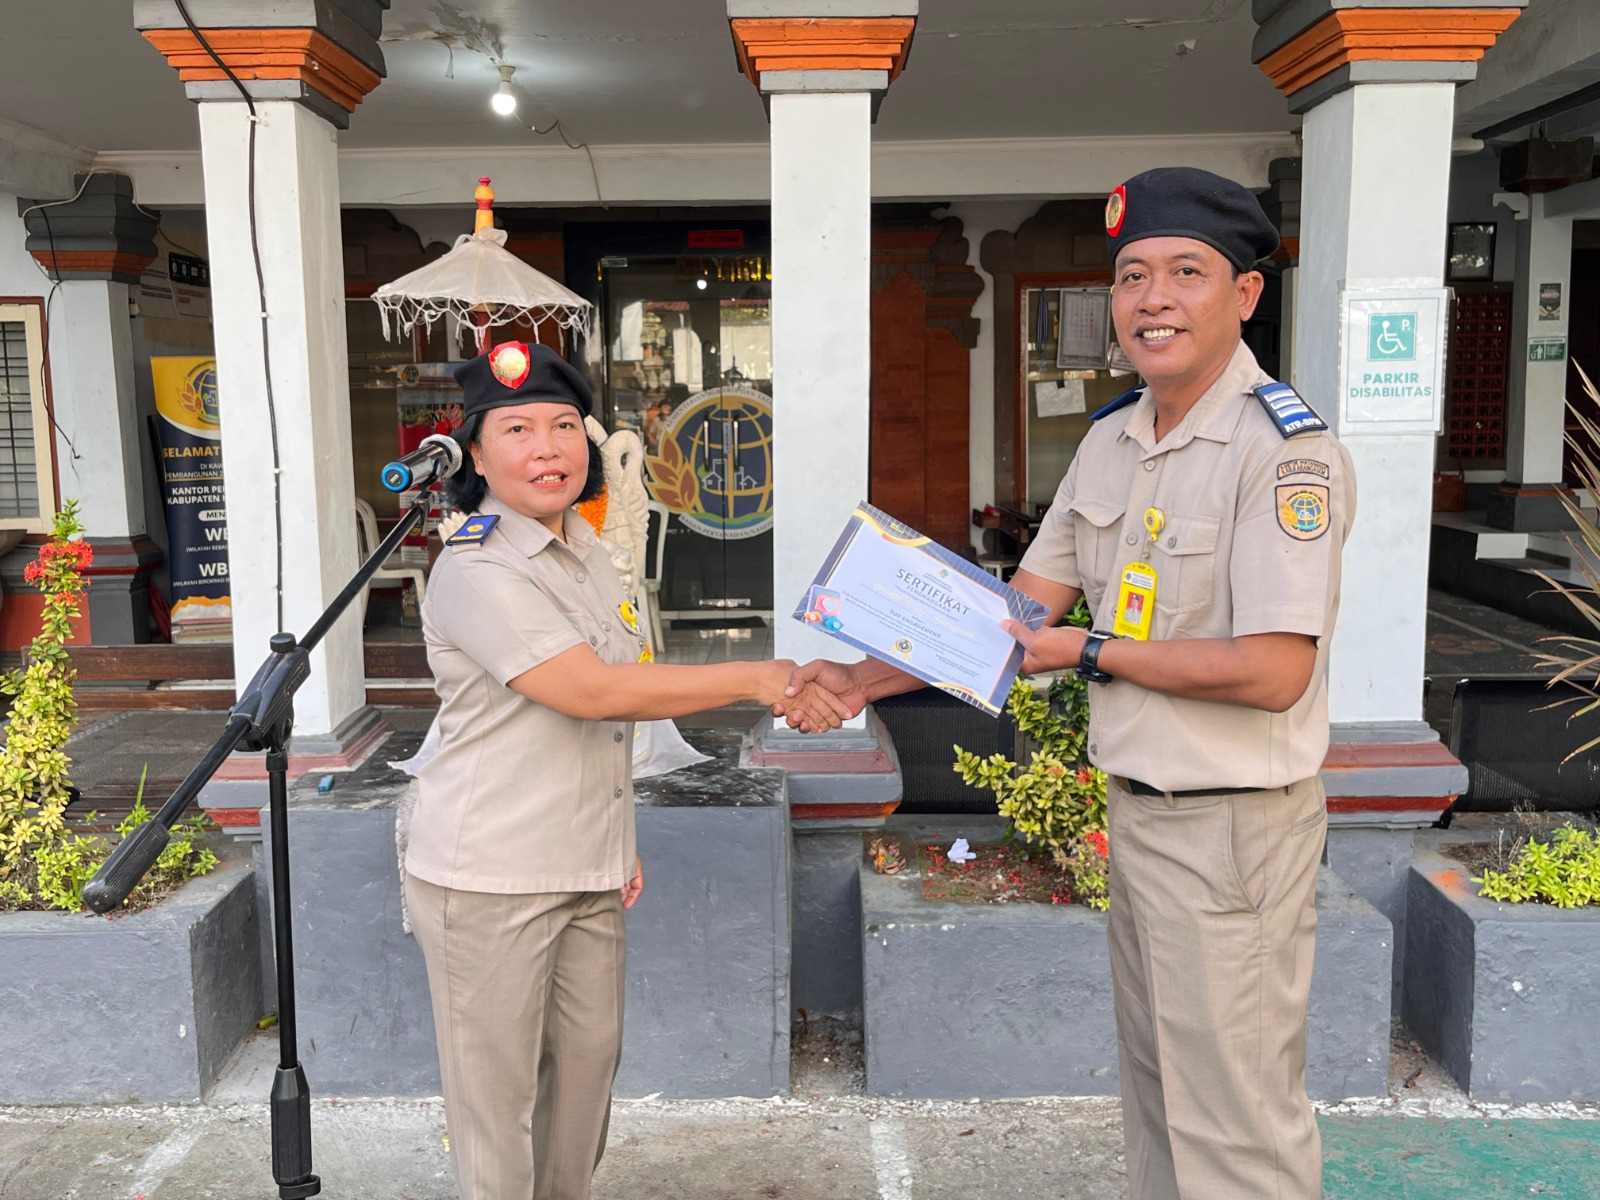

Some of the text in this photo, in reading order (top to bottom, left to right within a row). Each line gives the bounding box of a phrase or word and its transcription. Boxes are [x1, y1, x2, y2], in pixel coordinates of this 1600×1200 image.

[1402, 319, 1410, 331] P
[1363, 373, 1419, 384] PARKIR
[1350, 386, 1432, 398] DISABILITAS
[162, 445, 221, 458] SELAMAT
[172, 487, 209, 495] KANTOR
[167, 495, 220, 505] KABUPATEN
[206, 511, 226, 519] MEN
[199, 562, 228, 577] WB
[895, 568, 971, 616] SERTIFIKAT
